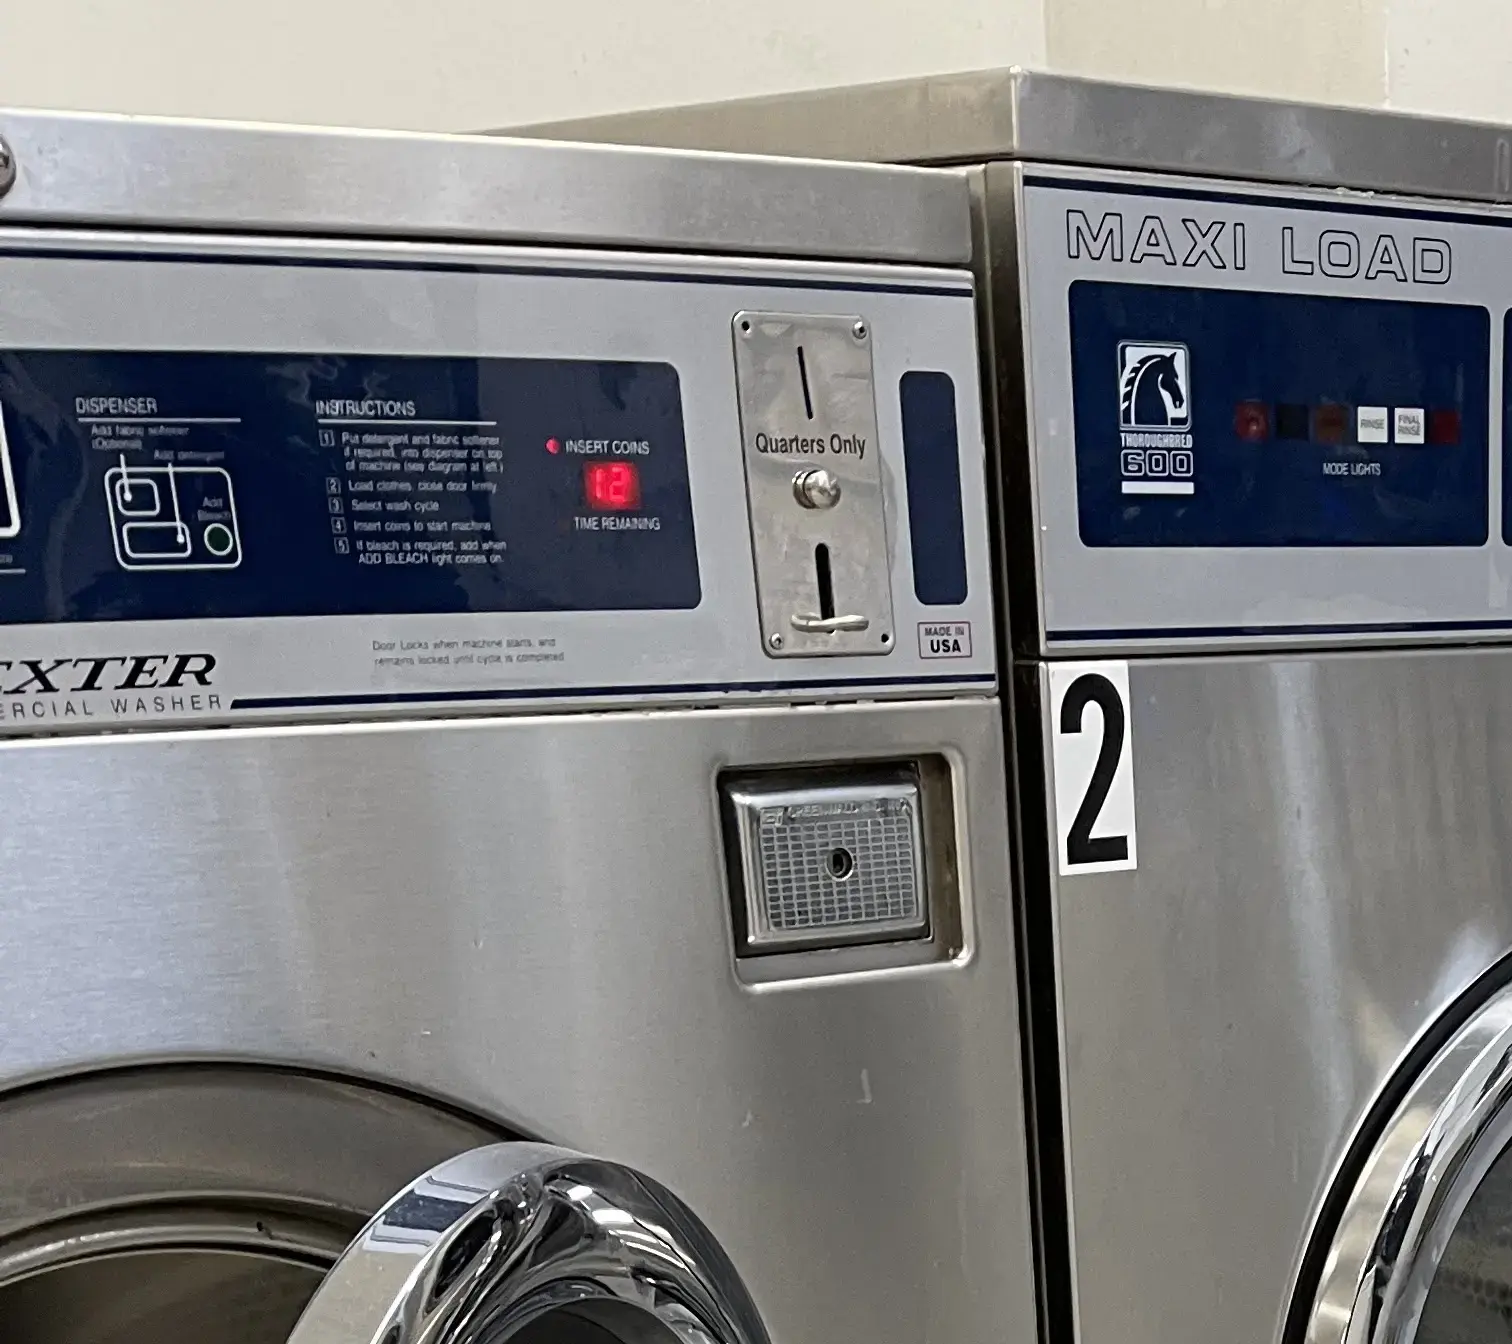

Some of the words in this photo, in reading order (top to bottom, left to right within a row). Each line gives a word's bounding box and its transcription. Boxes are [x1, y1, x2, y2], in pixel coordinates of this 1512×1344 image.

[1066, 209, 1246, 271] MAXI
[1281, 227, 1452, 285] LOAD
[75, 397, 158, 414] DISPENSER
[315, 400, 416, 417] INSTRUCTIONS
[1360, 418, 1385, 431] RINSE
[1397, 413, 1420, 425] FINAL
[341, 432, 360, 446] Put
[411, 434, 430, 445] and
[755, 432, 826, 454] Quarters
[829, 433, 867, 460] Only
[1119, 432, 1194, 449] THOROUGHBRED
[565, 440, 609, 454] INSERT
[611, 440, 651, 455] COINS
[1120, 450, 1194, 477] 600
[1322, 462, 1349, 476] MODE
[1350, 463, 1381, 477] LIGHTS
[348, 480, 374, 491] Load
[446, 480, 467, 491] door
[351, 499, 382, 511] Select
[385, 499, 412, 511] wash
[413, 520, 424, 531] to
[574, 516, 600, 531] TIME
[601, 517, 662, 532] REMAINING
[365, 540, 400, 551] bleach
[460, 540, 479, 551] add
[358, 553, 382, 565] ADD
[385, 553, 429, 566] BLEACH
[431, 552, 453, 567] light
[455, 554, 488, 565] comes
[924, 626, 952, 637] MADE
[373, 640, 396, 651] Door
[400, 640, 429, 650] Locks
[433, 640, 459, 649] when
[462, 639, 503, 649] machine
[929, 638, 962, 654] USA
[0, 653, 218, 695] XTER
[110, 694, 223, 714] WASHER
[1060, 673, 1129, 865] 2
